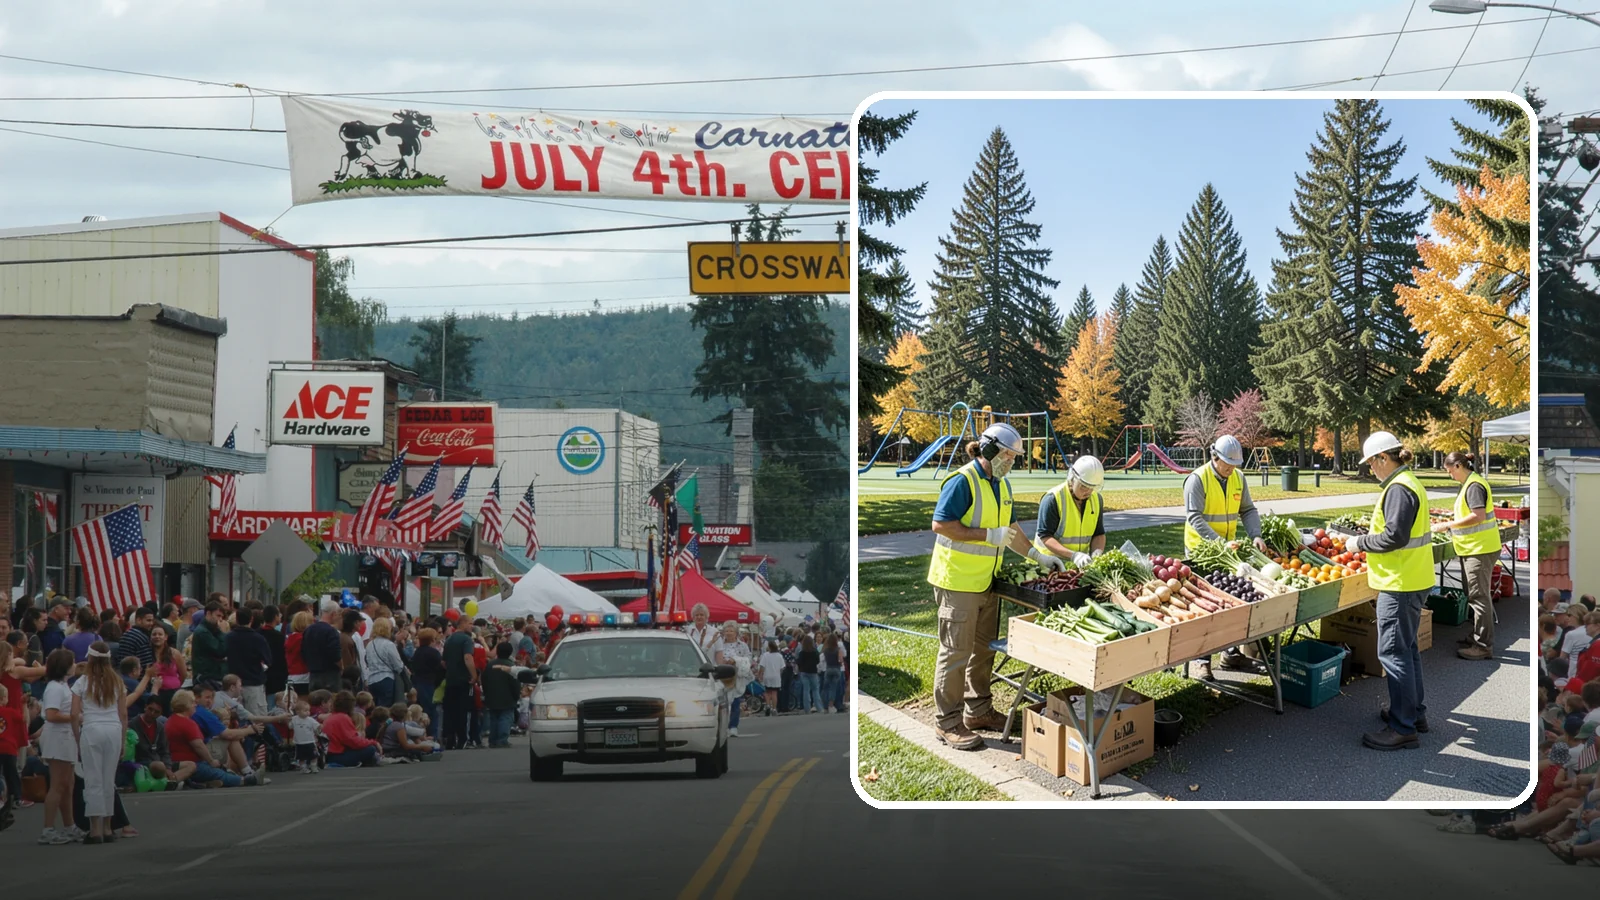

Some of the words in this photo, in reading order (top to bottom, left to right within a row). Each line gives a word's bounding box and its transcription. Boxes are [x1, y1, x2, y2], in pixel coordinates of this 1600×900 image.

[481, 141, 605, 192] JULY
[632, 150, 746, 197] 4th.
[697, 254, 850, 280] CROSSWA
[282, 380, 374, 420] ACE
[406, 409, 453, 422] CEDAR
[283, 421, 371, 437] Hardware
[416, 428, 477, 447] Coca-Cola
[354, 467, 387, 482] Simpl
[95, 485, 124, 495] Vincent
[126, 486, 136, 495] de
[137, 485, 155, 495] Paul
[688, 526, 742, 535] CRNATION
[699, 535, 730, 543] GLASS
